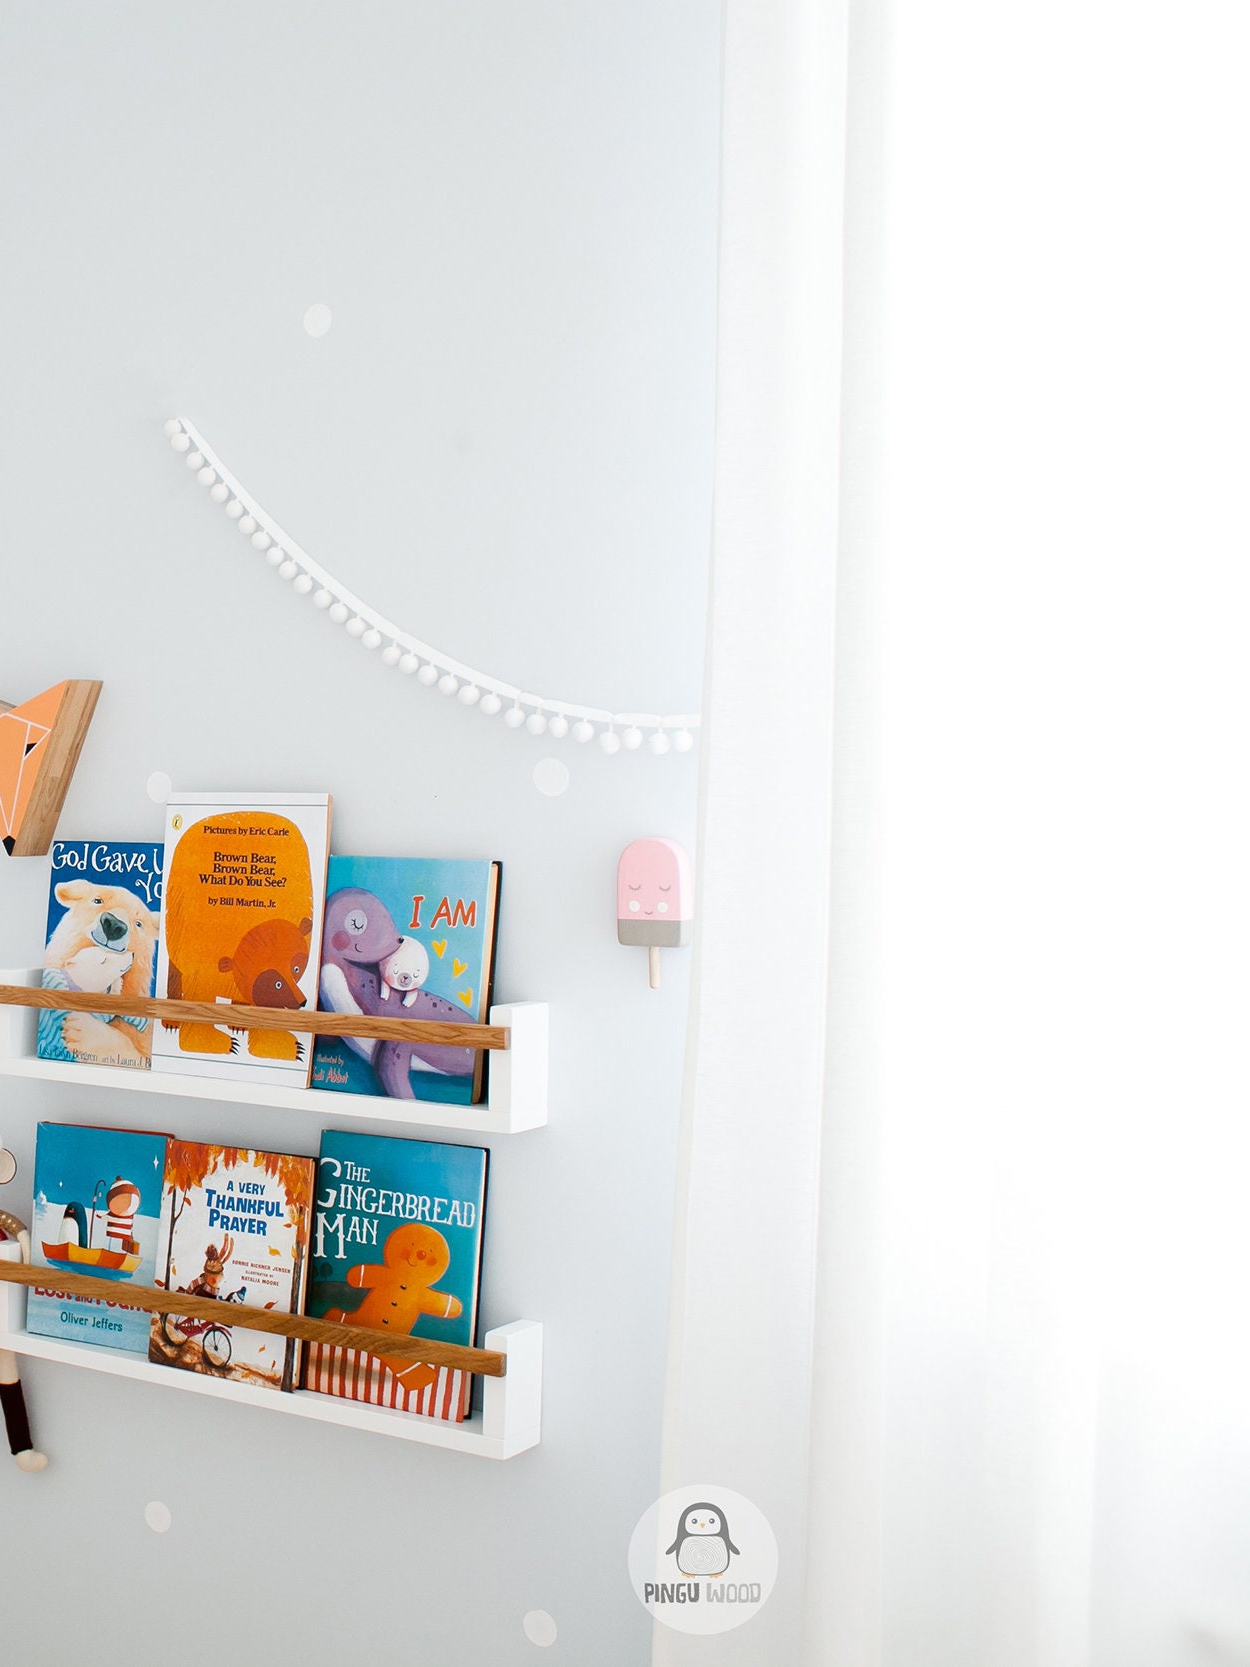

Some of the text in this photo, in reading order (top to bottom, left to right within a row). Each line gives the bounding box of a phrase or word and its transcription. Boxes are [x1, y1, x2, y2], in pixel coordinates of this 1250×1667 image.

[203, 825, 289, 837] Pictures by Eric Carle
[51, 843, 165, 875] God Gave U
[213, 851, 276, 864] Brown Bear,
[213, 863, 276, 876] Brown Bear,
[135, 872, 164, 903] Yo
[199, 874, 287, 887] What Do You See?
[208, 897, 218, 906] by
[220, 897, 233, 906] Bill
[236, 898, 266, 908] Martin,
[409, 895, 477, 930] I AM
[117, 1054, 136, 1067] Laura
[344, 1161, 371, 1183] THE
[226, 1180, 266, 1196] A VERY
[317, 1157, 476, 1228] GINGERBREAD
[205, 1188, 284, 1217] THANKFUL
[208, 1208, 267, 1236] PRAYER
[313, 1212, 379, 1259] MAN
[60, 1311, 123, 1332] Oliver Jeffers
